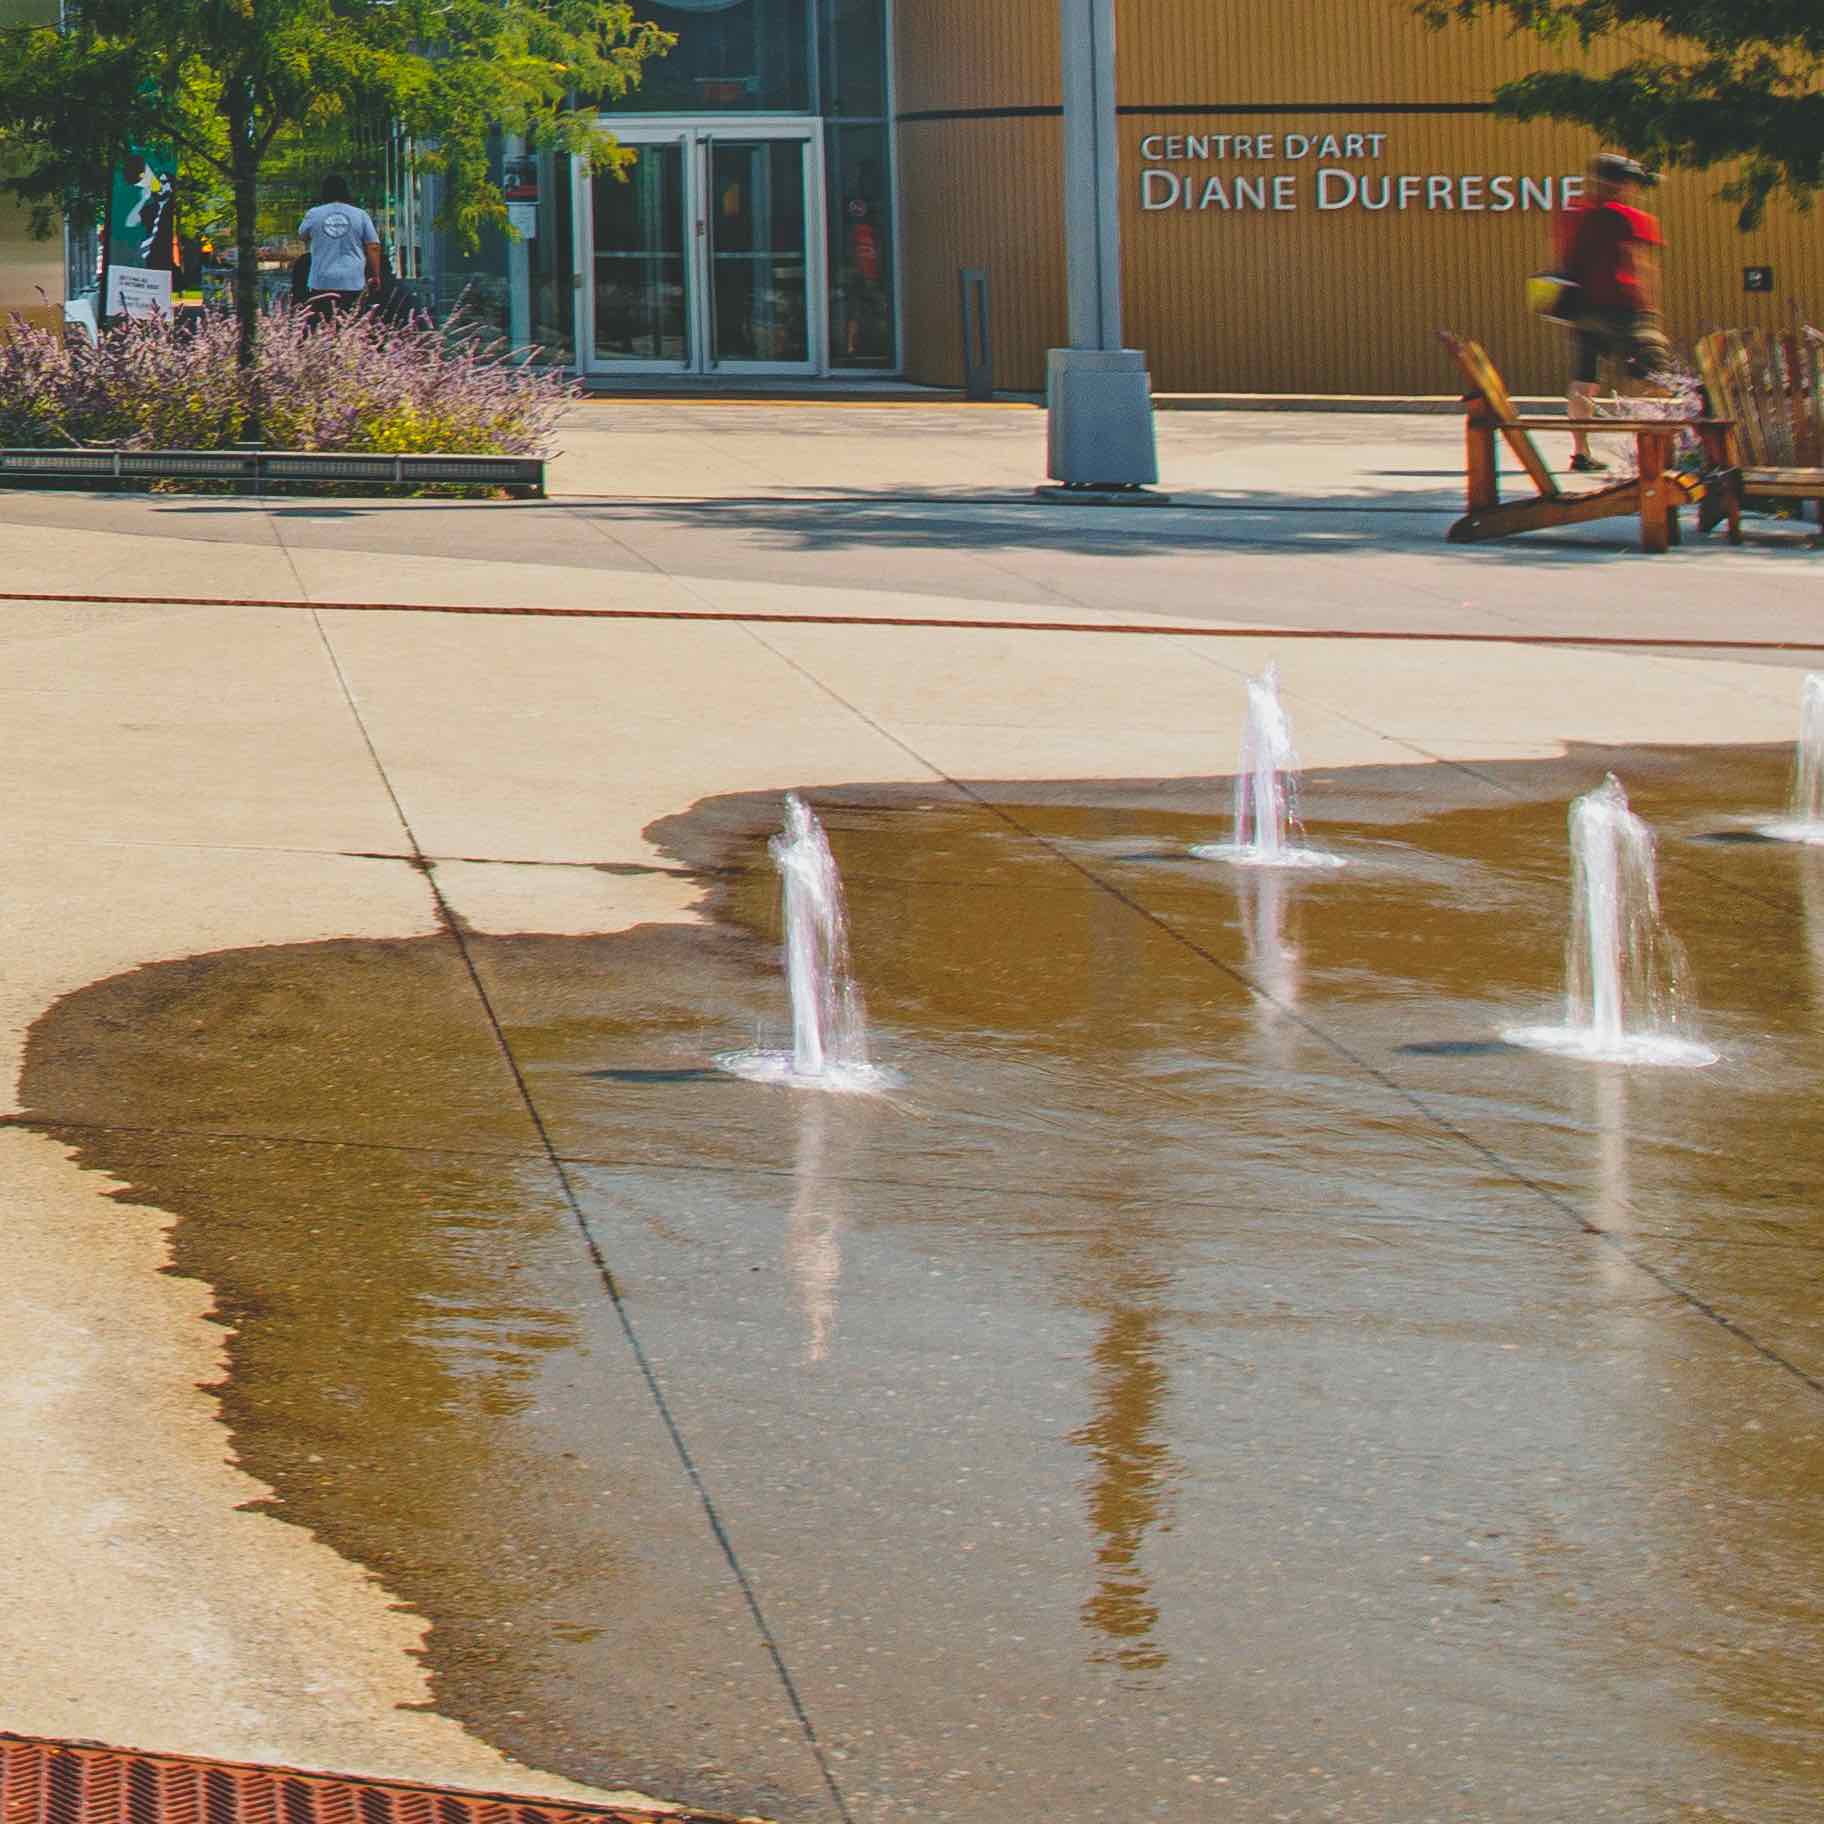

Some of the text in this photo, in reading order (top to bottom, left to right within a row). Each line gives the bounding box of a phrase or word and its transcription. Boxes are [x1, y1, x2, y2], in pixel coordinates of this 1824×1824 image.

[1140, 133, 1387, 161] CENTRE D'ART
[1140, 167, 1586, 212] DIANE DUFRESNE
